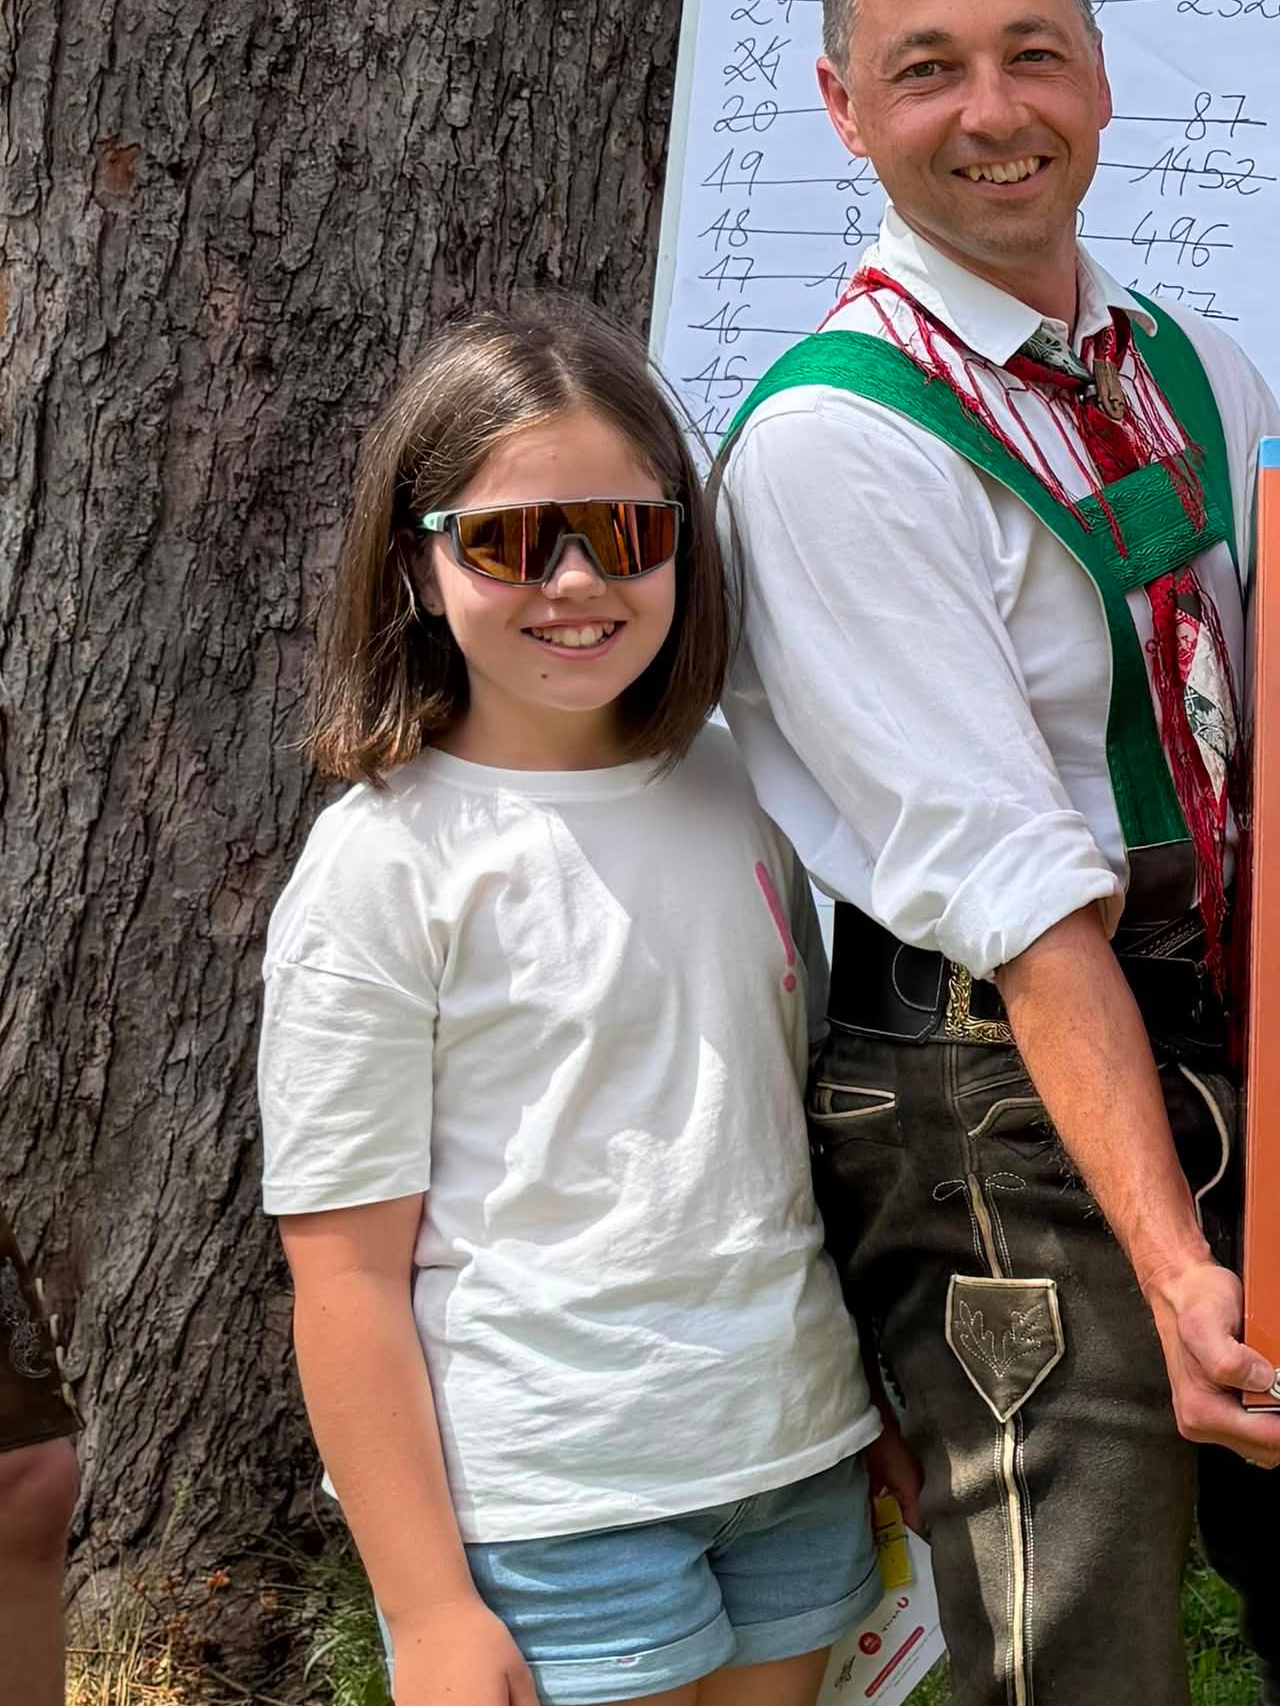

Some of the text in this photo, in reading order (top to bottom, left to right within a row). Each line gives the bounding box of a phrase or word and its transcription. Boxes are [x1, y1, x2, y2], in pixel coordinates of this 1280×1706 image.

[713, 92, 1246, 140] 20 87
[704, 148, 764, 196] 19
[1129, 144, 1262, 196] 1452
[698, 208, 750, 252] 18
[1131, 211, 1229, 267] 496
[705, 255, 754, 293] 17
[699, 302, 751, 344] 16
[694, 356, 747, 403] 15
